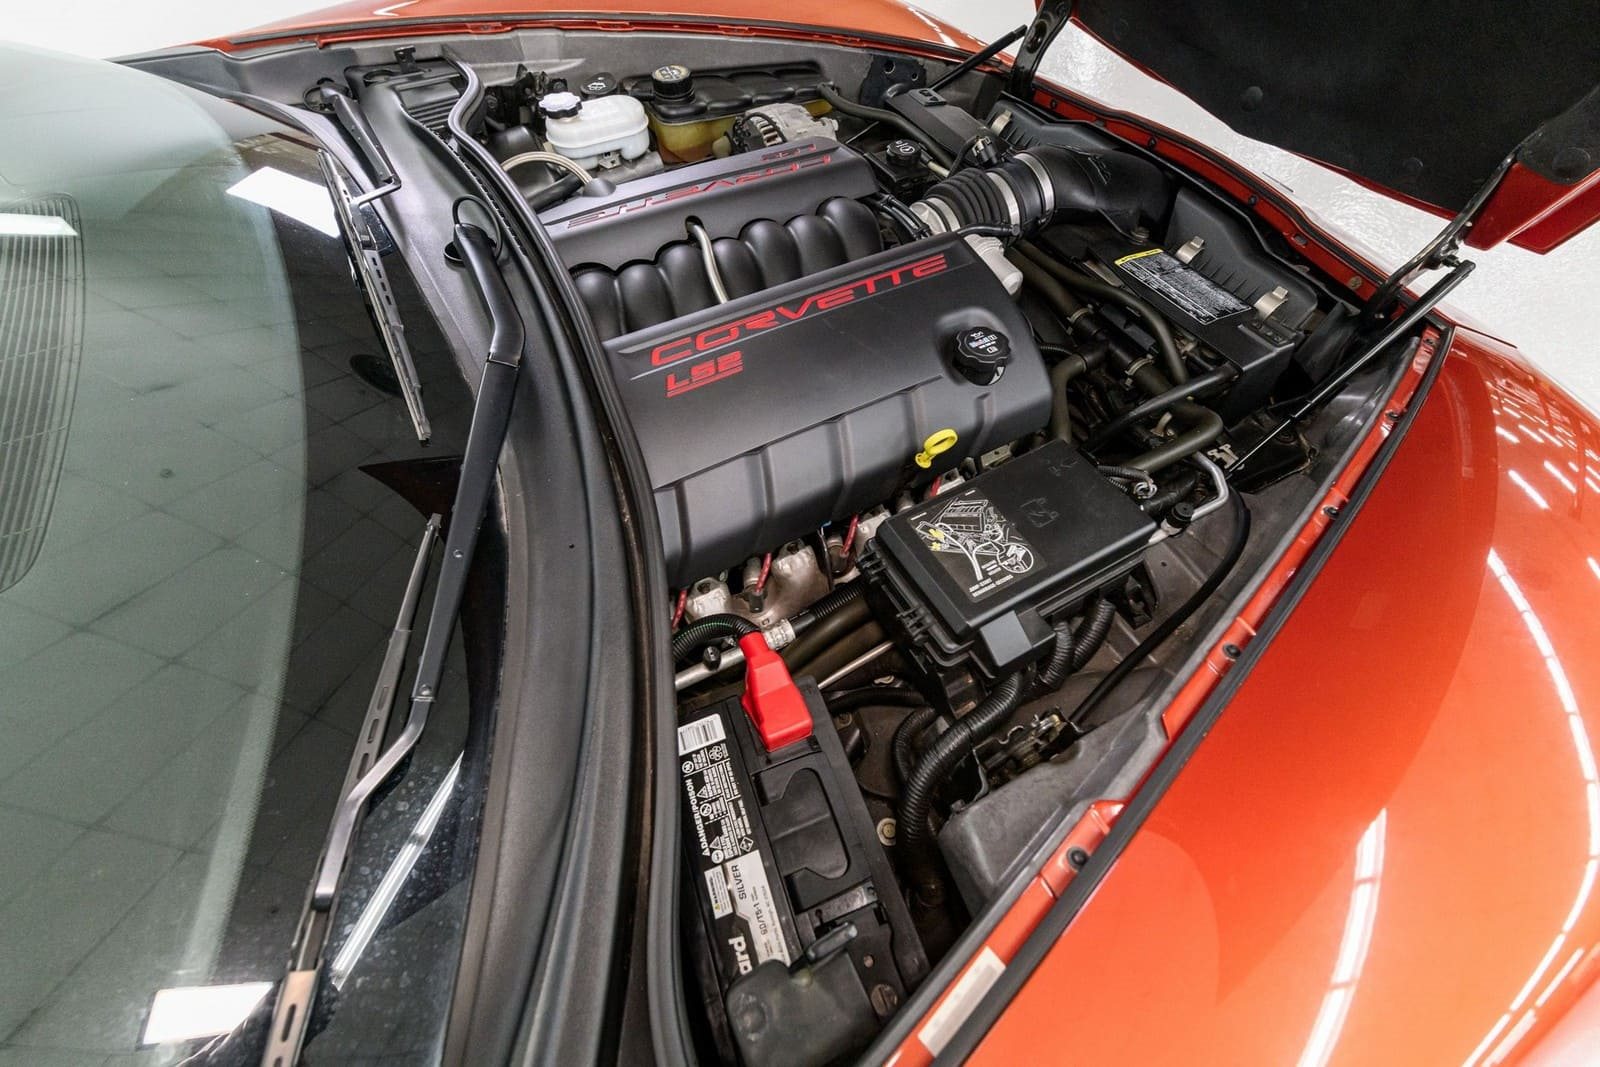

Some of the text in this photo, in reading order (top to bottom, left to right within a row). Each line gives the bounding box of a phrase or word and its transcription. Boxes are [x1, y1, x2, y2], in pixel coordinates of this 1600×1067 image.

[650, 254, 947, 367] CORVETTE
[666, 350, 743, 392] LS2
[731, 864, 746, 900] SILVER
[727, 935, 753, 976] ard
